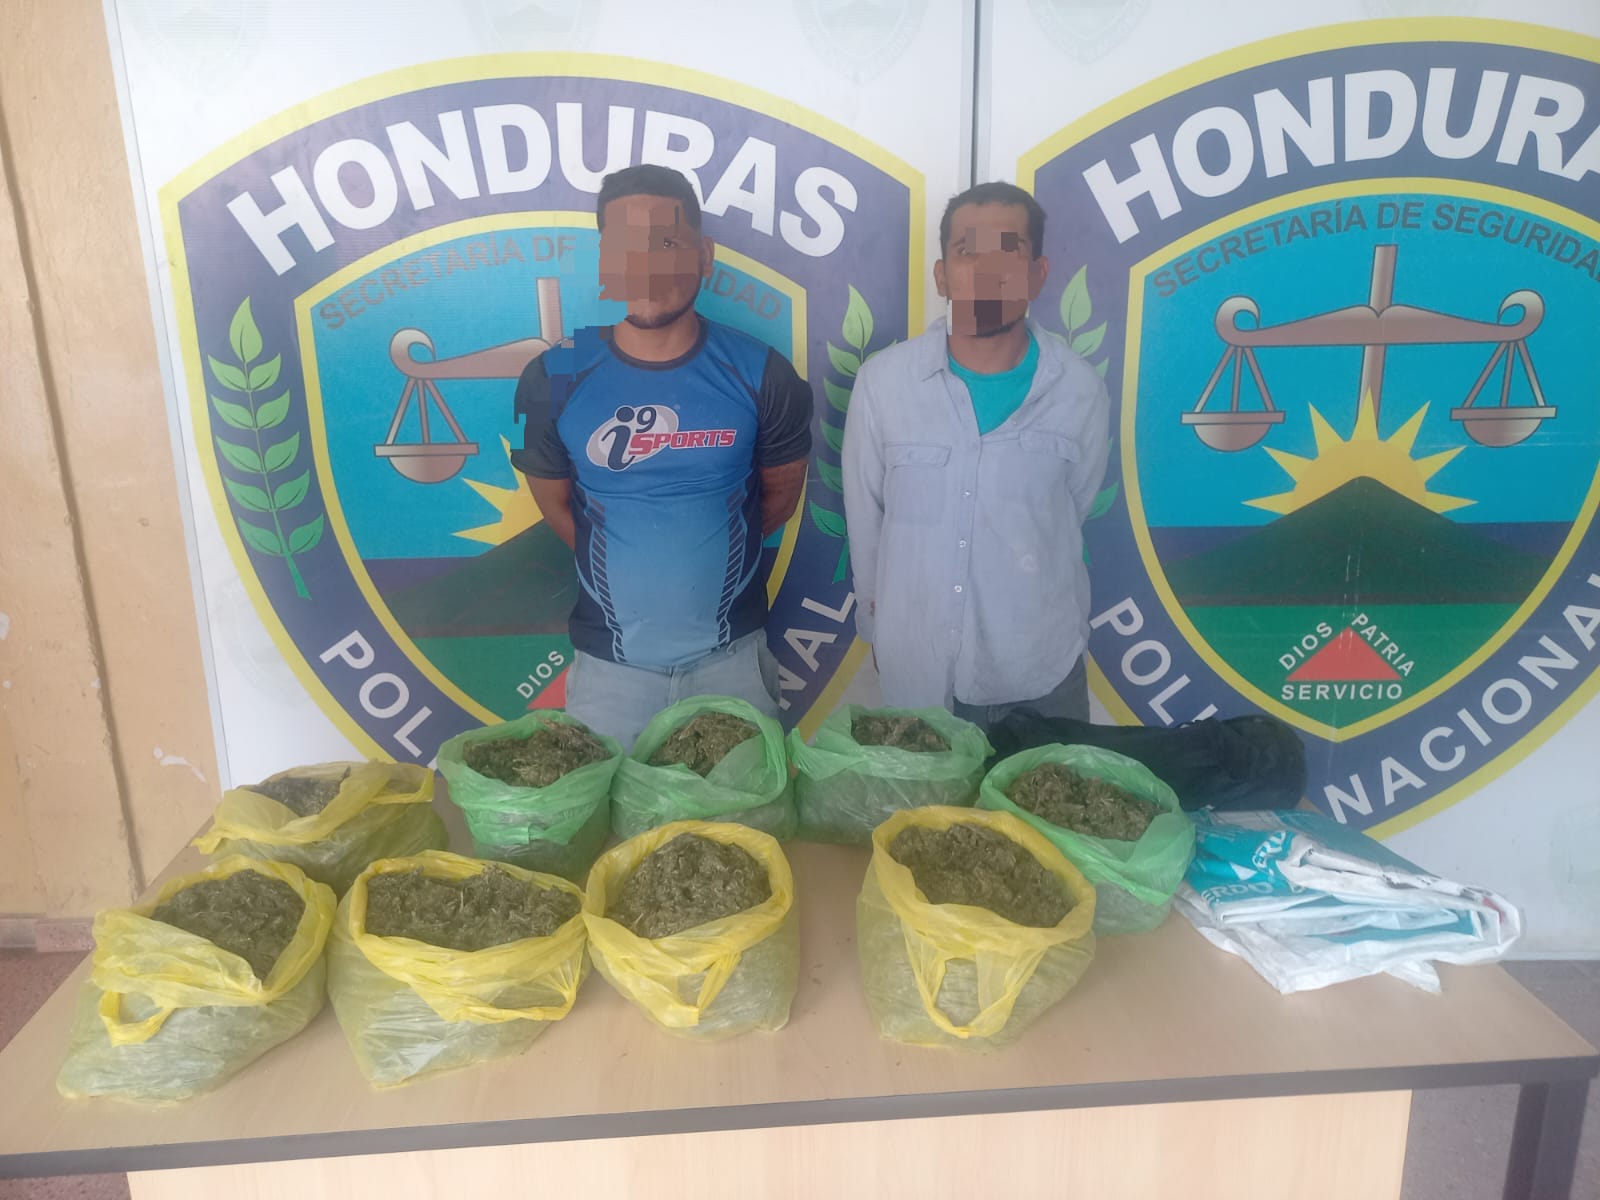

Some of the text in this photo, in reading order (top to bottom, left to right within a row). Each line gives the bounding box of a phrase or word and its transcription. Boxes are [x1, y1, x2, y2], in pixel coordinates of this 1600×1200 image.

[227, 102, 858, 275] HONDURAS
[1153, 201, 1600, 298] SECRETARÍA DE SEGURIDA
[628, 429, 737, 456] SPORTS
[516, 650, 565, 699] DIOS
[1278, 622, 1333, 671] DIOS
[1351, 612, 1415, 677] PATRIA
[319, 630, 437, 771] POL
[1281, 683, 1403, 700] SERVICIO
[1323, 573, 1600, 824] NACIONA
